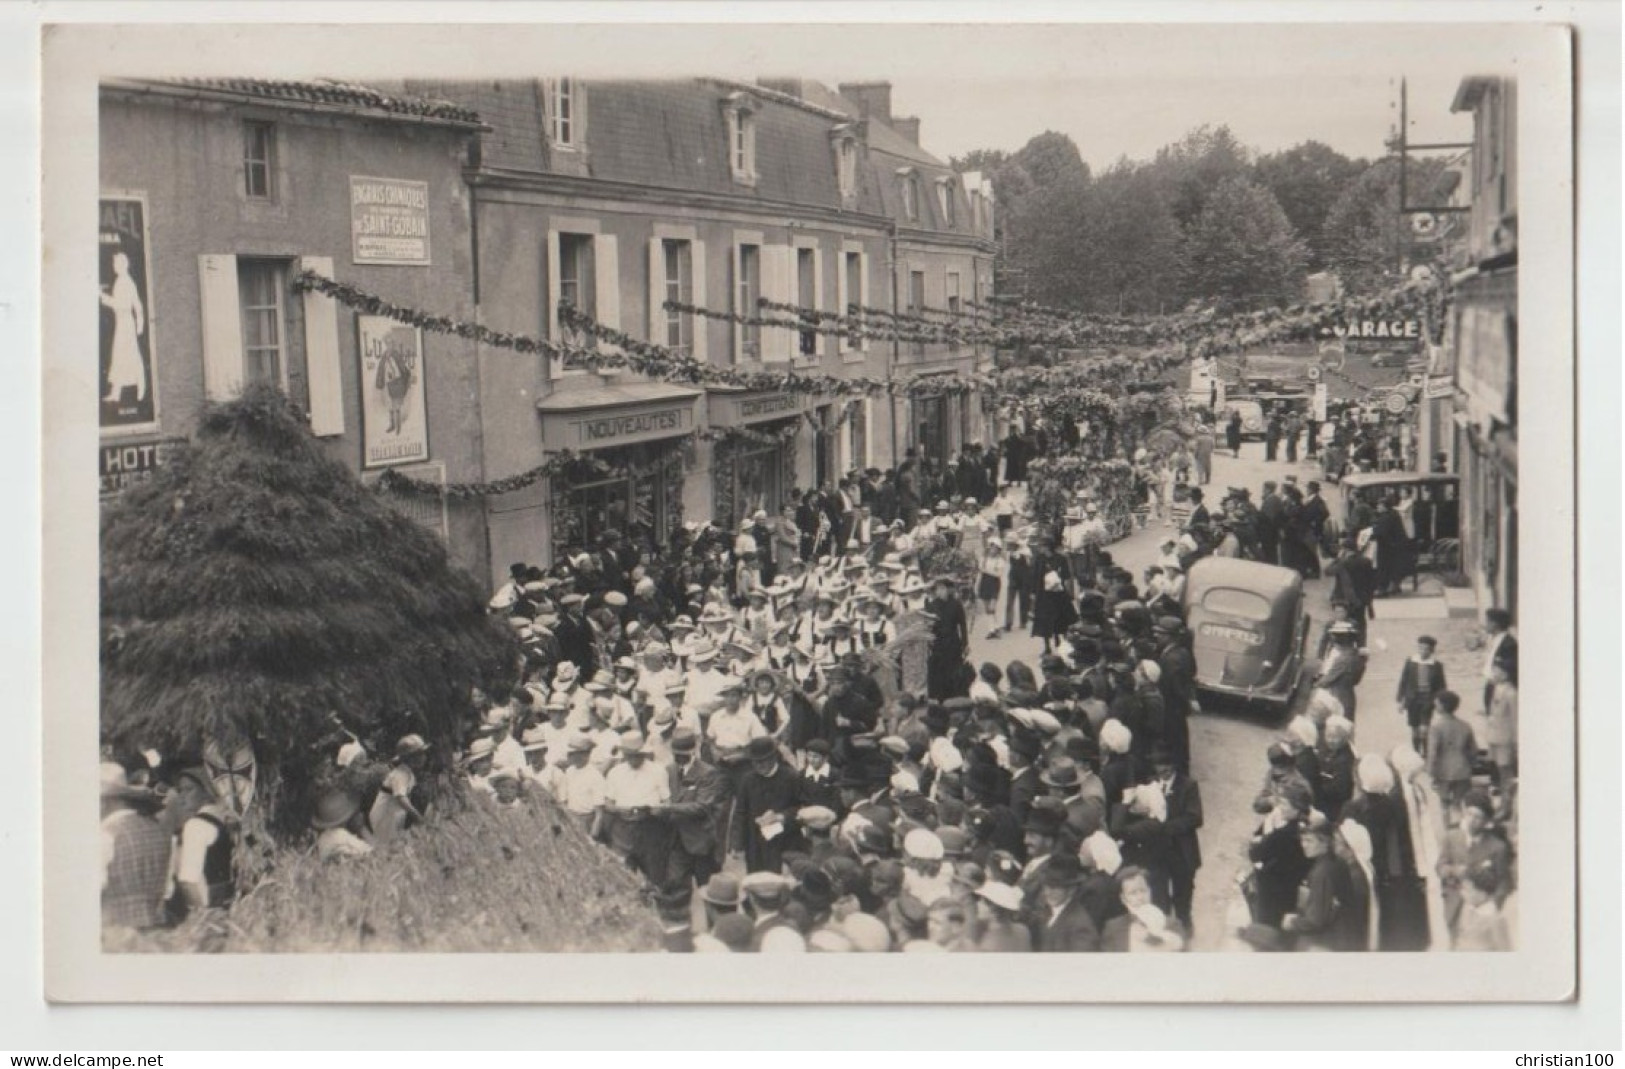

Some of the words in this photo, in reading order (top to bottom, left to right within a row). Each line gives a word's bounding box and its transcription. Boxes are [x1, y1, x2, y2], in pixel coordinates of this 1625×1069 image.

[353, 184, 385, 205] ENGRAIS
[386, 186, 425, 209] CHIMIQUES
[362, 214, 426, 236] SAINT-GOBAIN
[363, 331, 382, 359] LU
